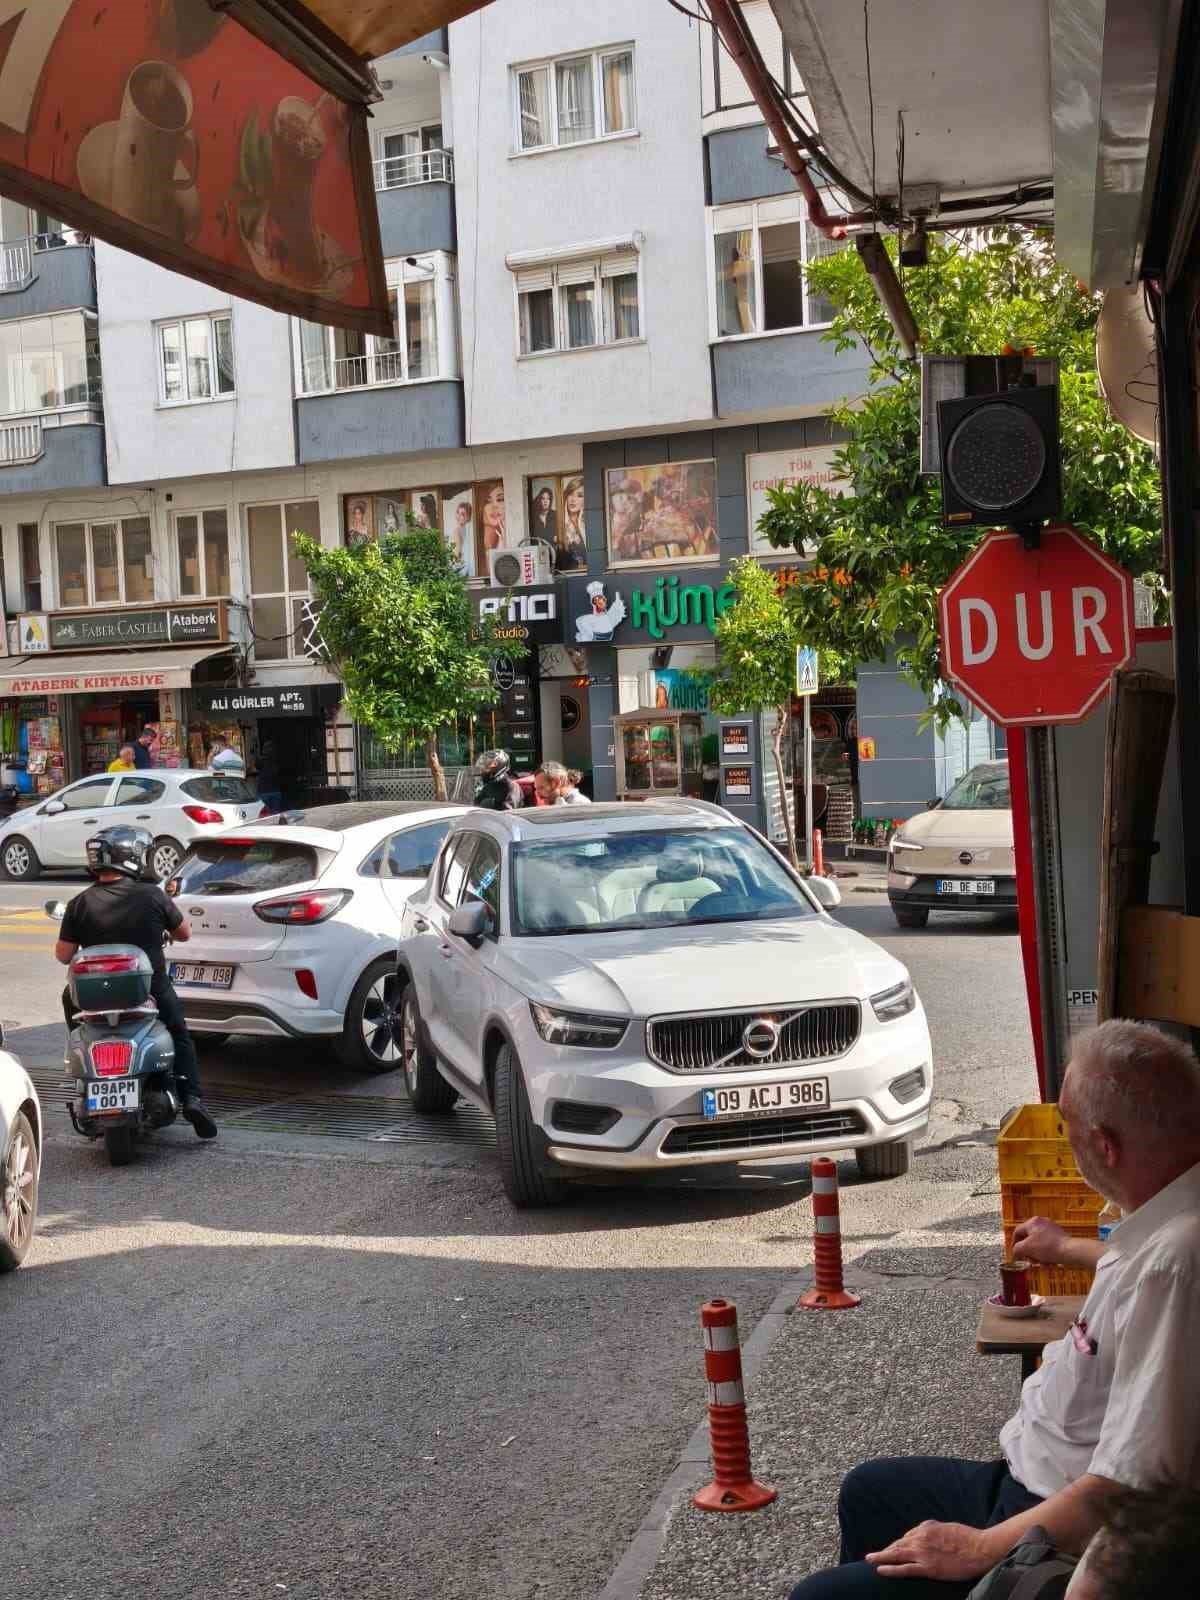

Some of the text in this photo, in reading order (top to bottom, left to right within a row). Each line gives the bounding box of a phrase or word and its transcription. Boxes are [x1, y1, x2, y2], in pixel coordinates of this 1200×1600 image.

[172, 611, 216, 626] Ataberk
[958, 586, 1113, 666] DUR
[10, 674, 166, 693] ATABERK KIRTASİYE
[211, 692, 303, 710] ALİ GÜRLER APT.
[943, 881, 953, 892] 09
[175, 966, 186, 980] 09
[212, 969, 231, 983] 098
[91, 1080, 135, 1096] 09APM
[100, 1094, 126, 1108] 001
[717, 1082, 823, 1112] 09 ACJ 986
